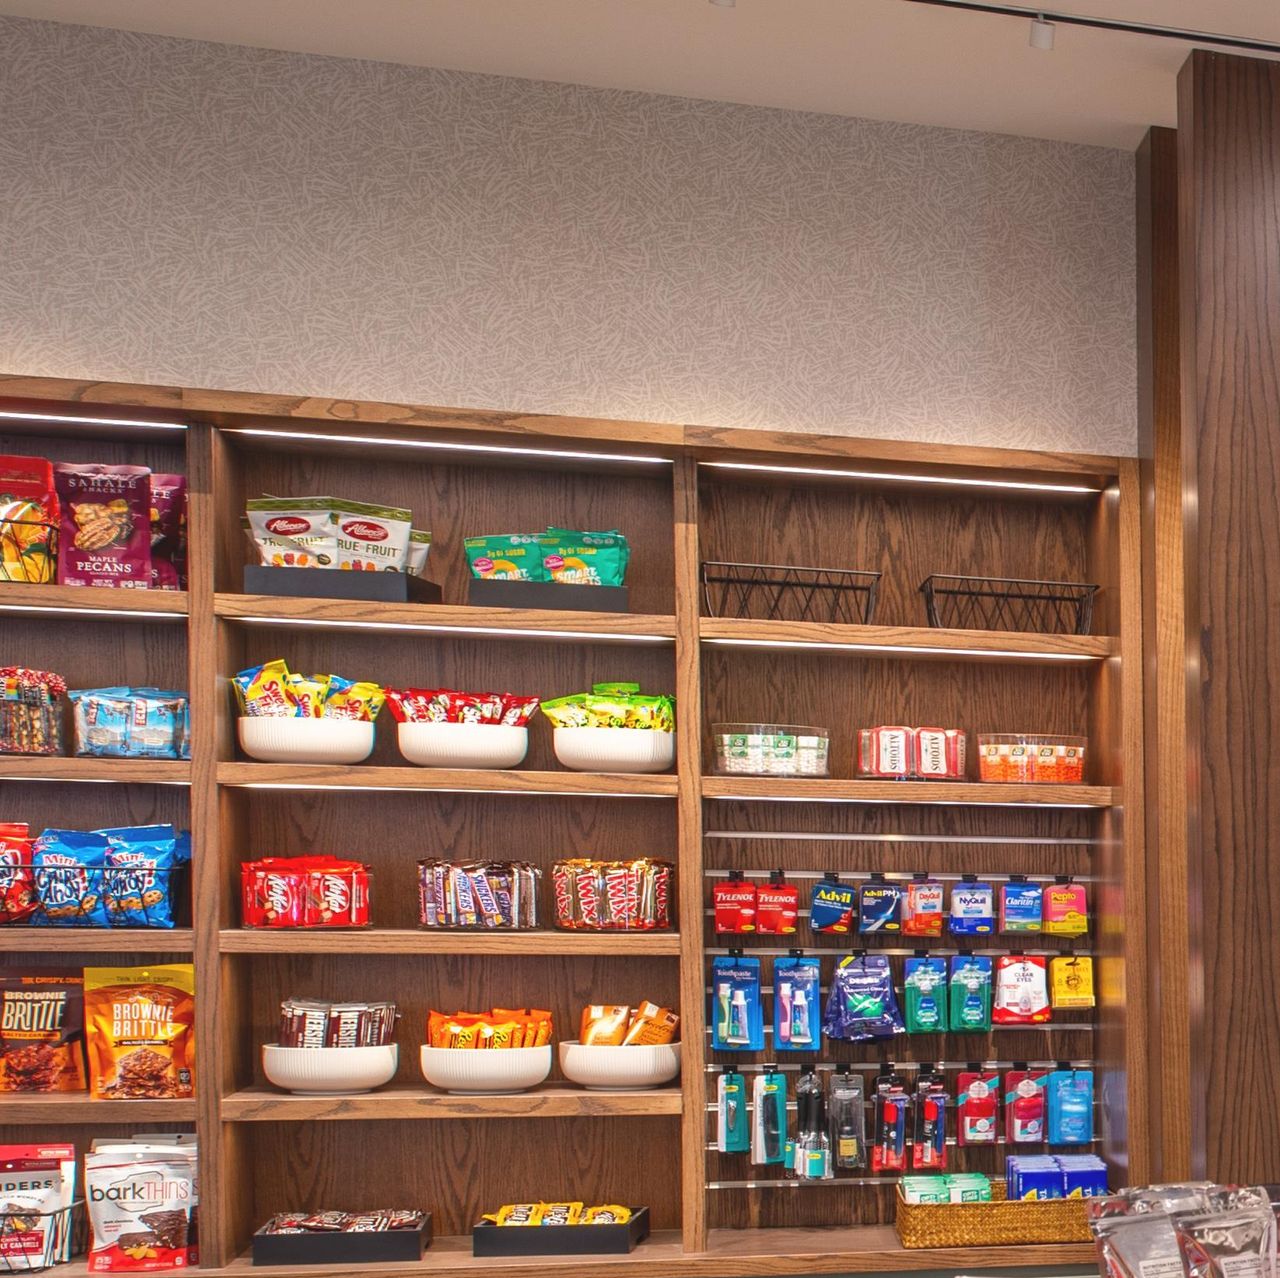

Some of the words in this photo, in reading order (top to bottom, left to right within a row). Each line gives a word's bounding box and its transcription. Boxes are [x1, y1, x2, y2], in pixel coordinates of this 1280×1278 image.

[68, 478, 137, 489] SAHALE
[366, 541, 397, 557] FRUIT
[77, 561, 132, 573] PECANS
[889, 734, 899, 770] ALTOIDS
[930, 735, 940, 771] ALTOIDS
[472, 875, 500, 913] SNICKERS
[716, 893, 754, 901] TYLENOL
[759, 894, 796, 903] TYLENOL
[817, 889, 851, 903] Advil
[1051, 892, 1077, 902] Pepto
[960, 897, 986, 906] NyQuil
[1005, 897, 1034, 906] Claritin
[717, 970, 751, 979] Toothpaste
[5, 991, 66, 1000] BROWNIE
[2, 1001, 65, 1031] BRITTLE
[113, 1003, 175, 1021] BROWNIE
[113, 1020, 175, 1038] BRITTLE
